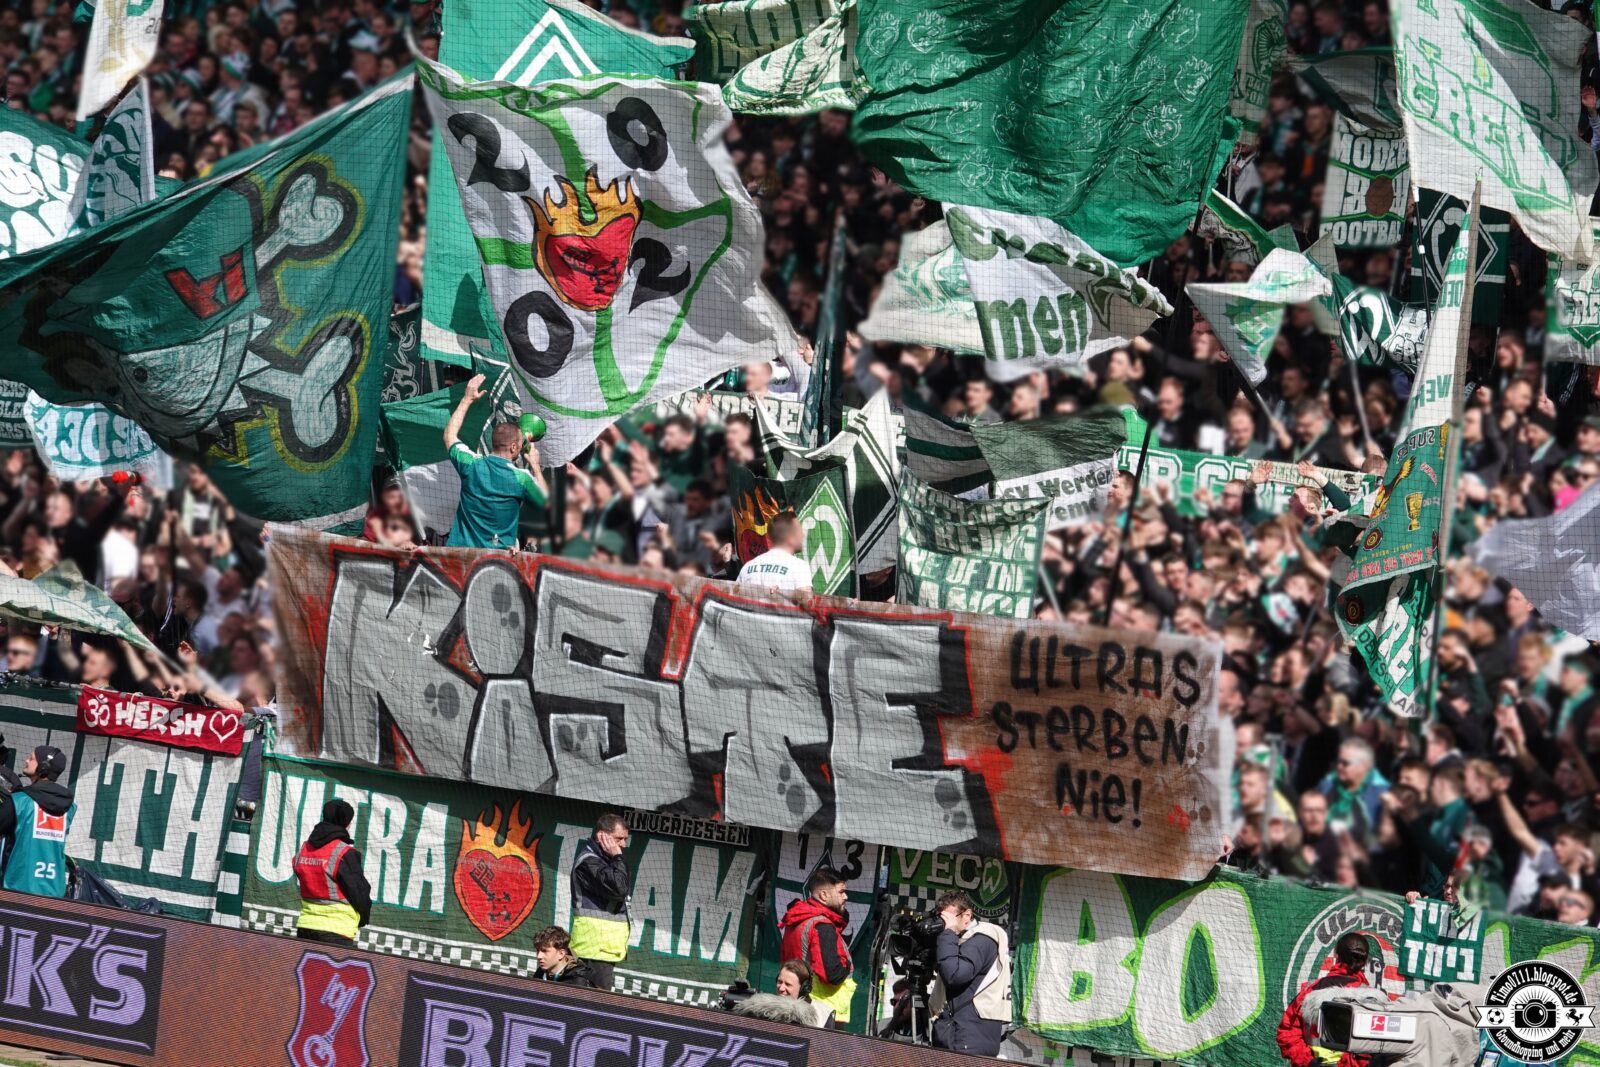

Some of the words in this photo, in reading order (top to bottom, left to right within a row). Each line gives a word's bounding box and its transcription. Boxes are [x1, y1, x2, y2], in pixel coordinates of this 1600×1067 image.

[1334, 133, 1409, 171] MODER
[747, 563, 789, 576] ULTRAS
[1010, 630, 1201, 706] ULTRAS
[115, 700, 206, 738] HERSH
[624, 810, 749, 847] UNVERGESSEN
[34, 861, 56, 880] 25
[554, 822, 756, 963] TAM
[0, 923, 149, 1026] K'S
[419, 999, 790, 1067] BEC'
